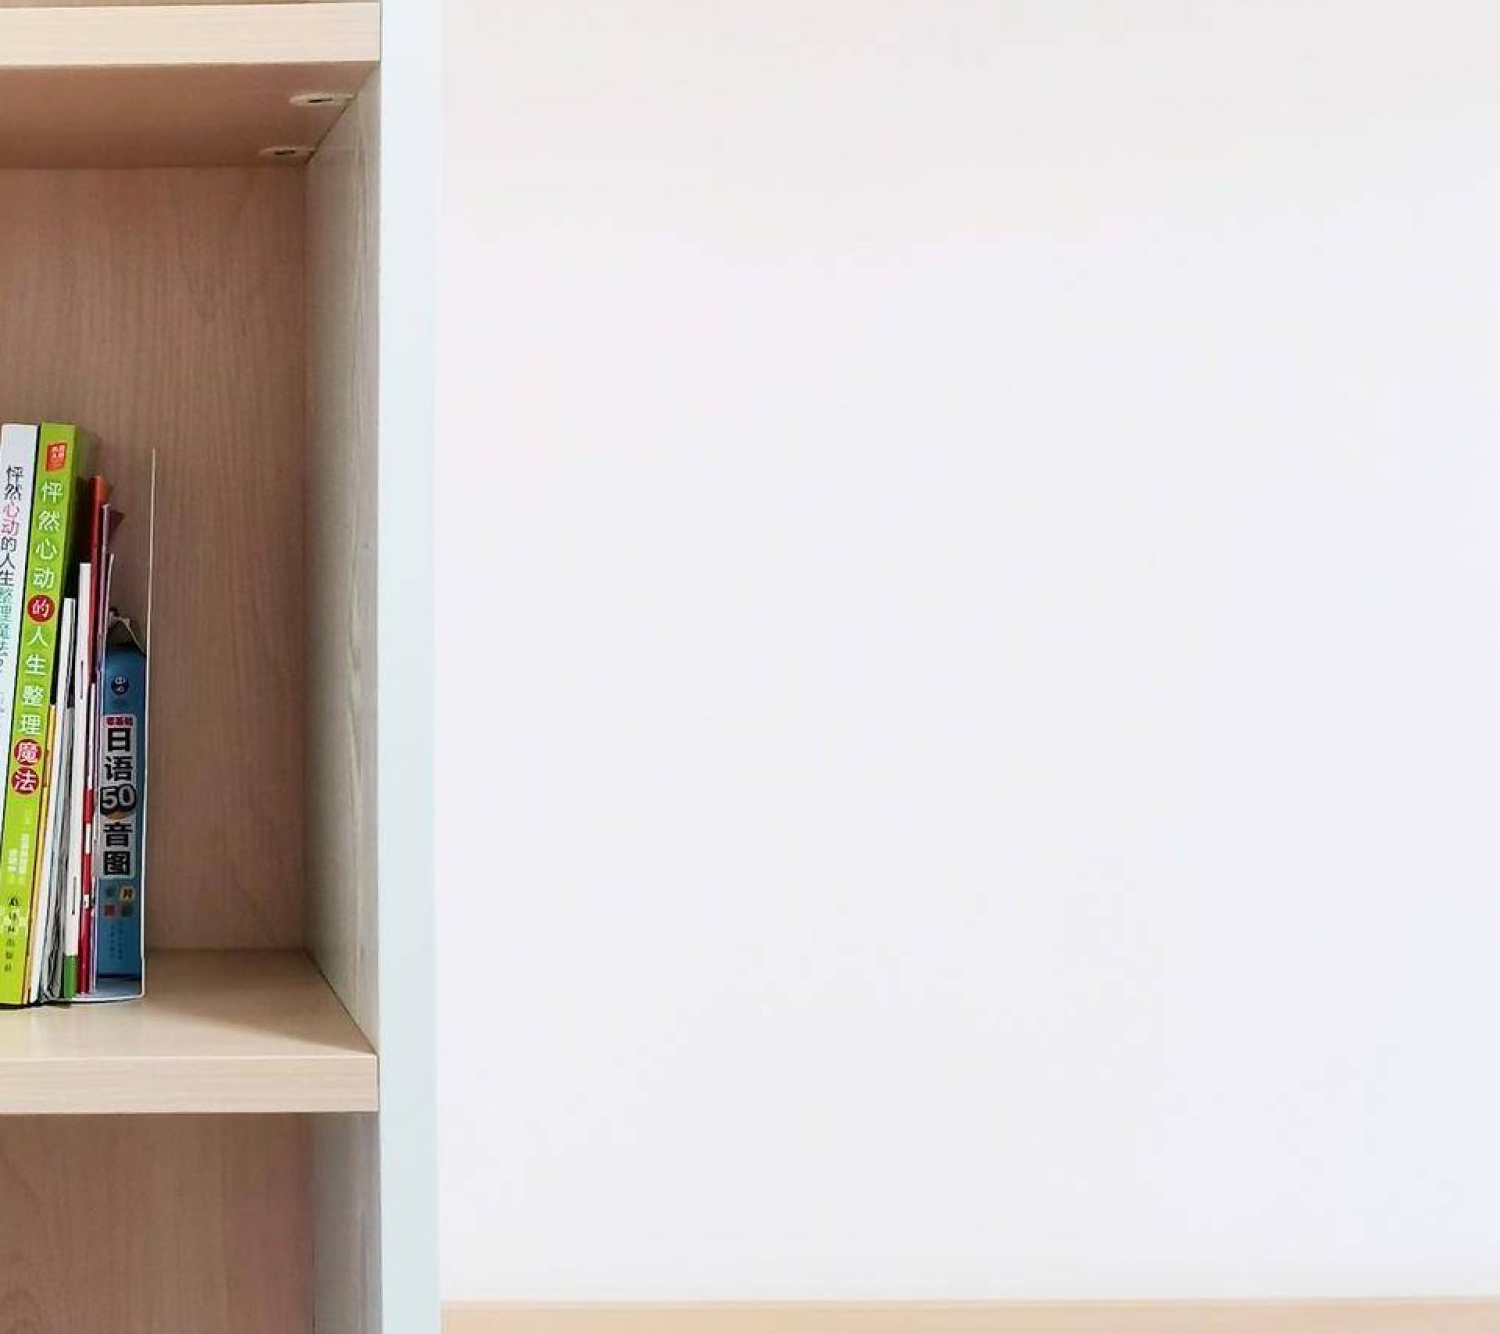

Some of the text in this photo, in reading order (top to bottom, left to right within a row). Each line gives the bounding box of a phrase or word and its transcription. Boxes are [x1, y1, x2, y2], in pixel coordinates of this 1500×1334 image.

[11, 479, 65, 795] 怦然心动的人生整理魔法
[99, 726, 137, 878] 日语50音图
